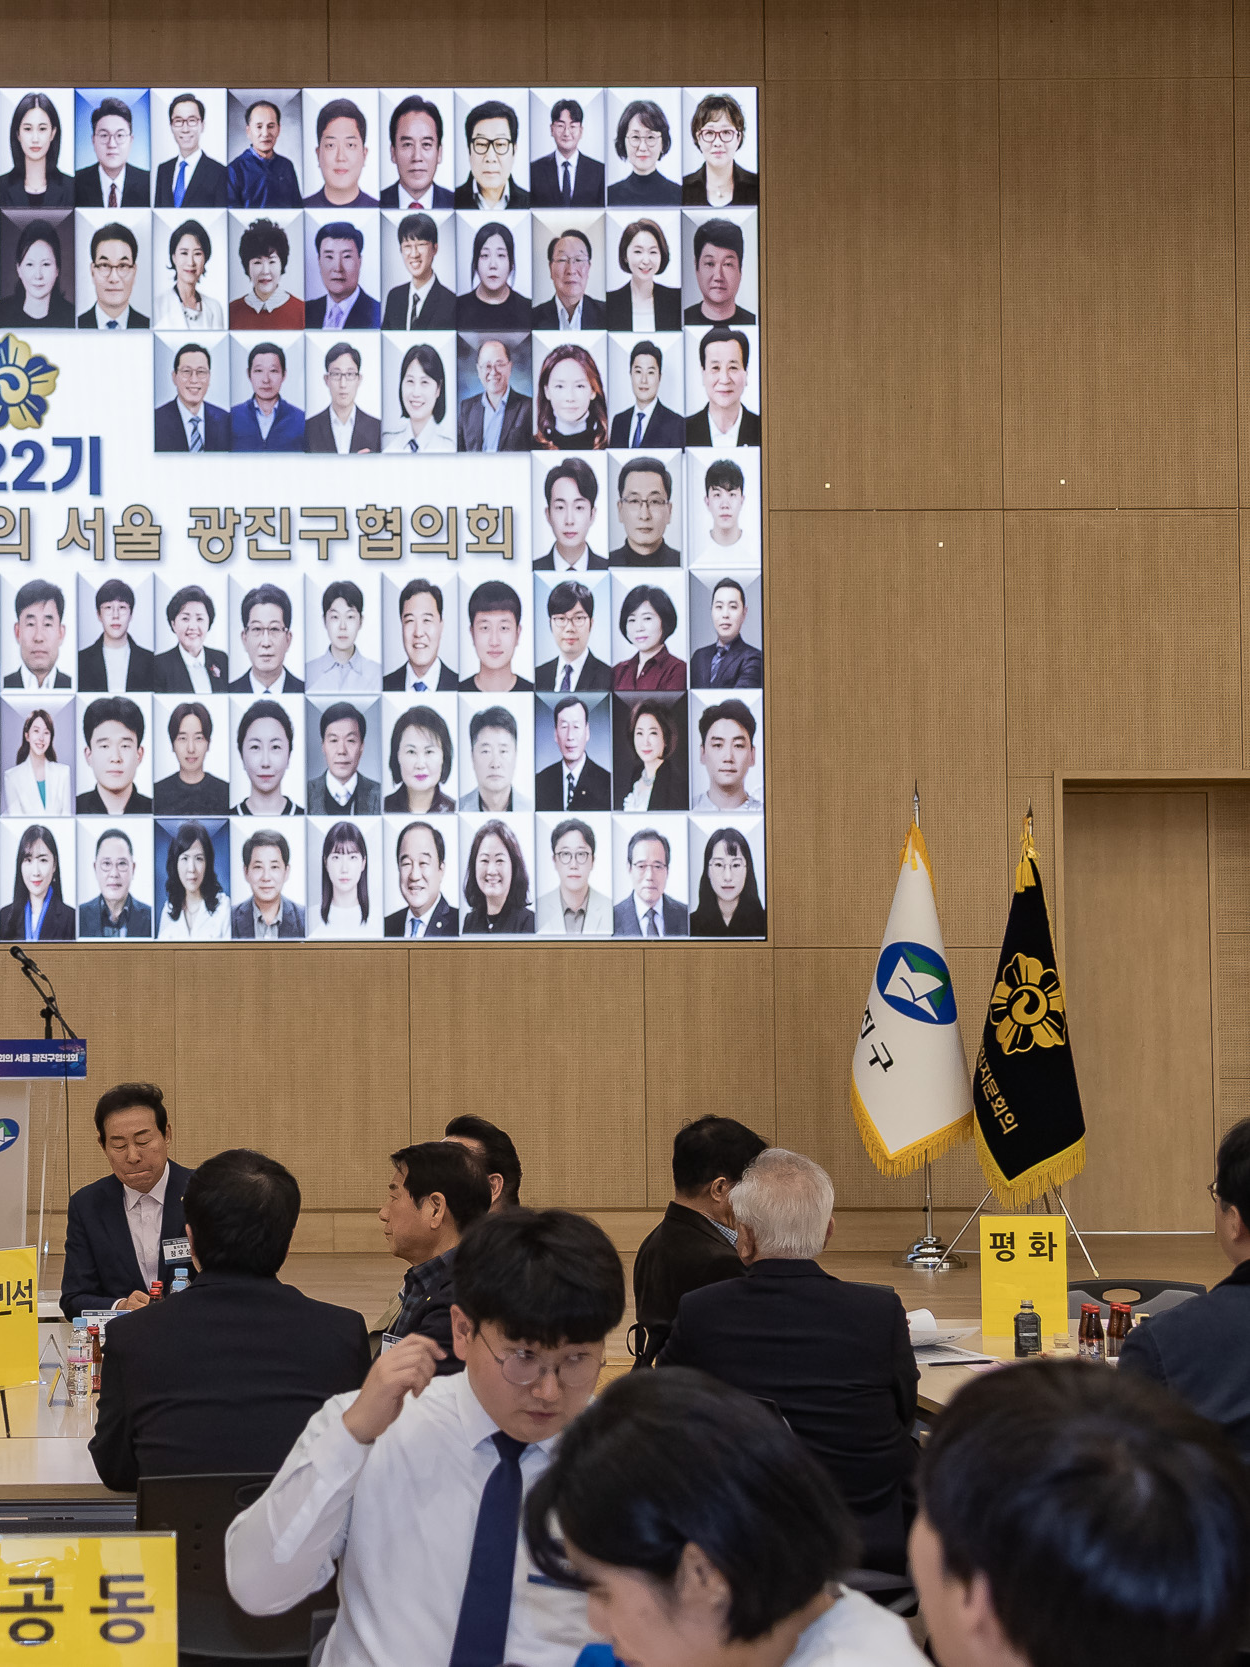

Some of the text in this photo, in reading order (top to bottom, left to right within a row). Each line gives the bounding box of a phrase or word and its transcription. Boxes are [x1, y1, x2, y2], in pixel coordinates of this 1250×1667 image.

[56, 504, 163, 562] 서울
[187, 504, 516, 564] 광진구협의회
[14, 1053, 30, 1063] 서울
[989, 1231, 1058, 1262] 평화
